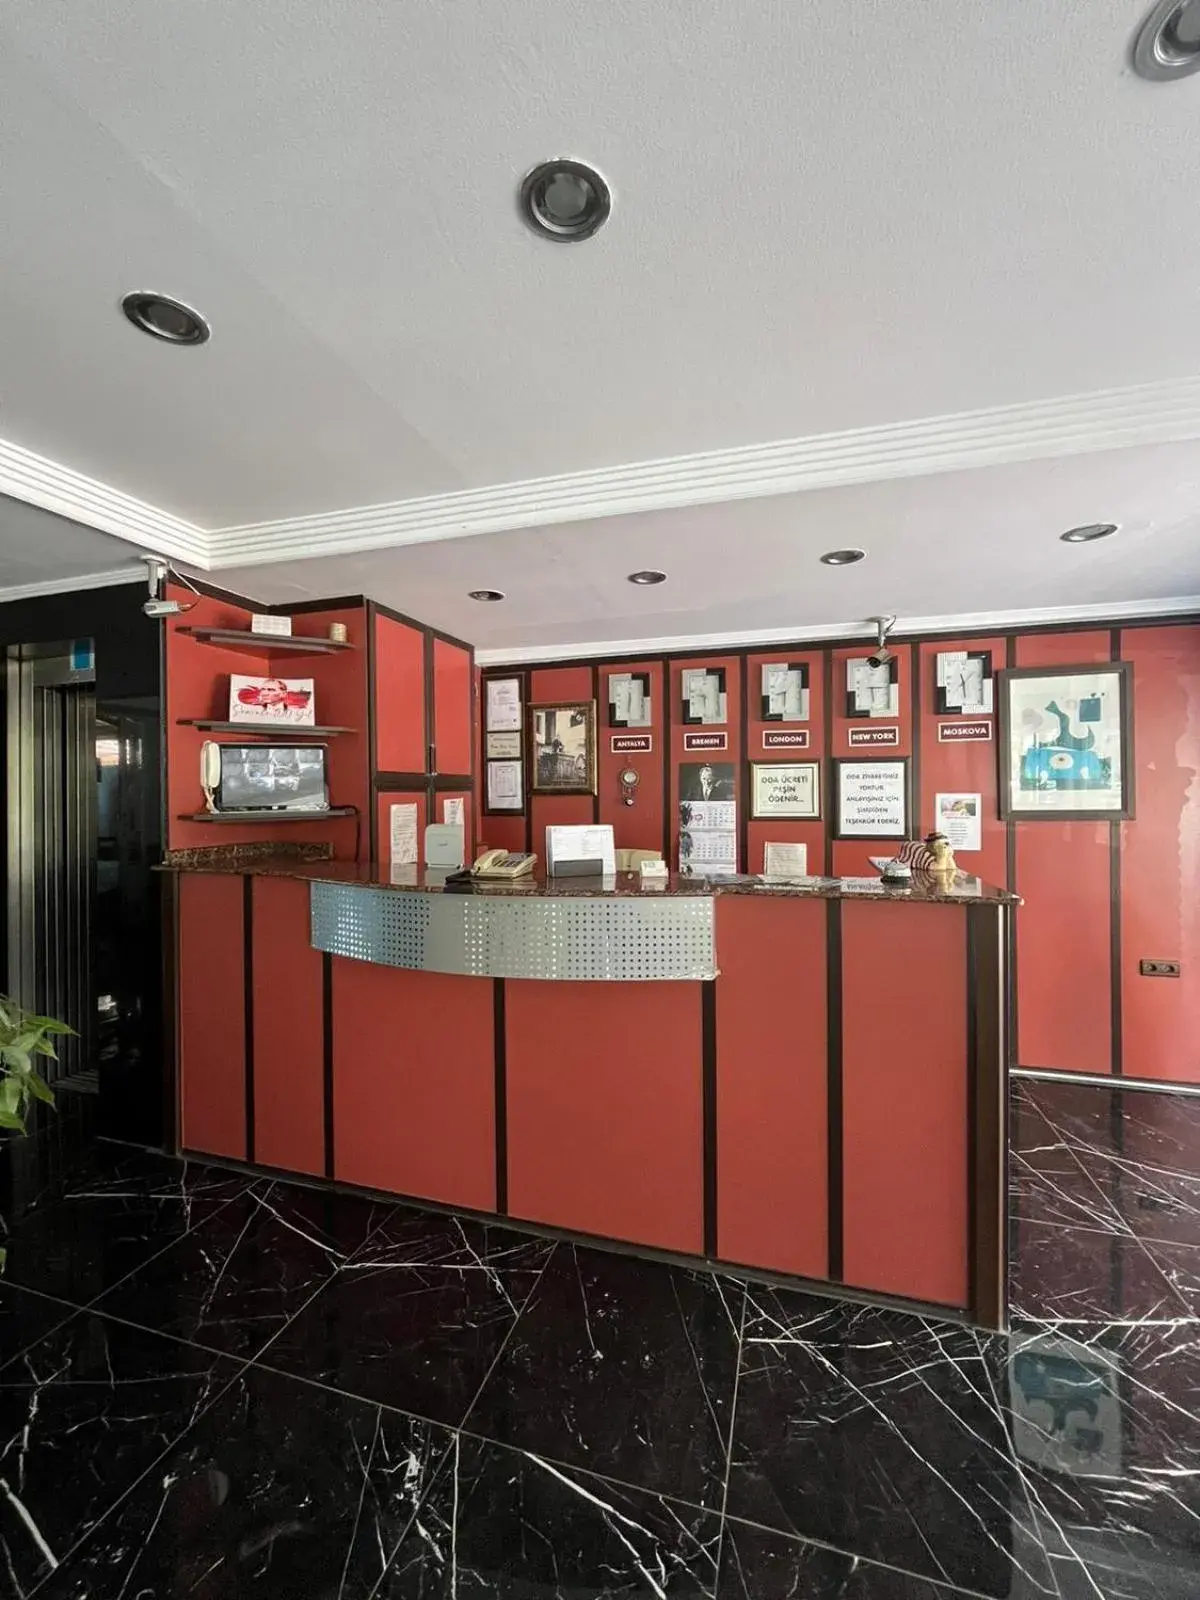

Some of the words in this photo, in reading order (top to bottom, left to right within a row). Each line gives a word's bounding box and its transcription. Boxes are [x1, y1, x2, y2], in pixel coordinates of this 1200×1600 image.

[943, 727, 987, 736] MOSKOVA
[769, 735, 802, 743] LONDON
[852, 733, 870, 741] NEW
[872, 732, 895, 740] YORK
[616, 740, 646, 748] ANTALYA
[691, 737, 720, 745] BREMEN
